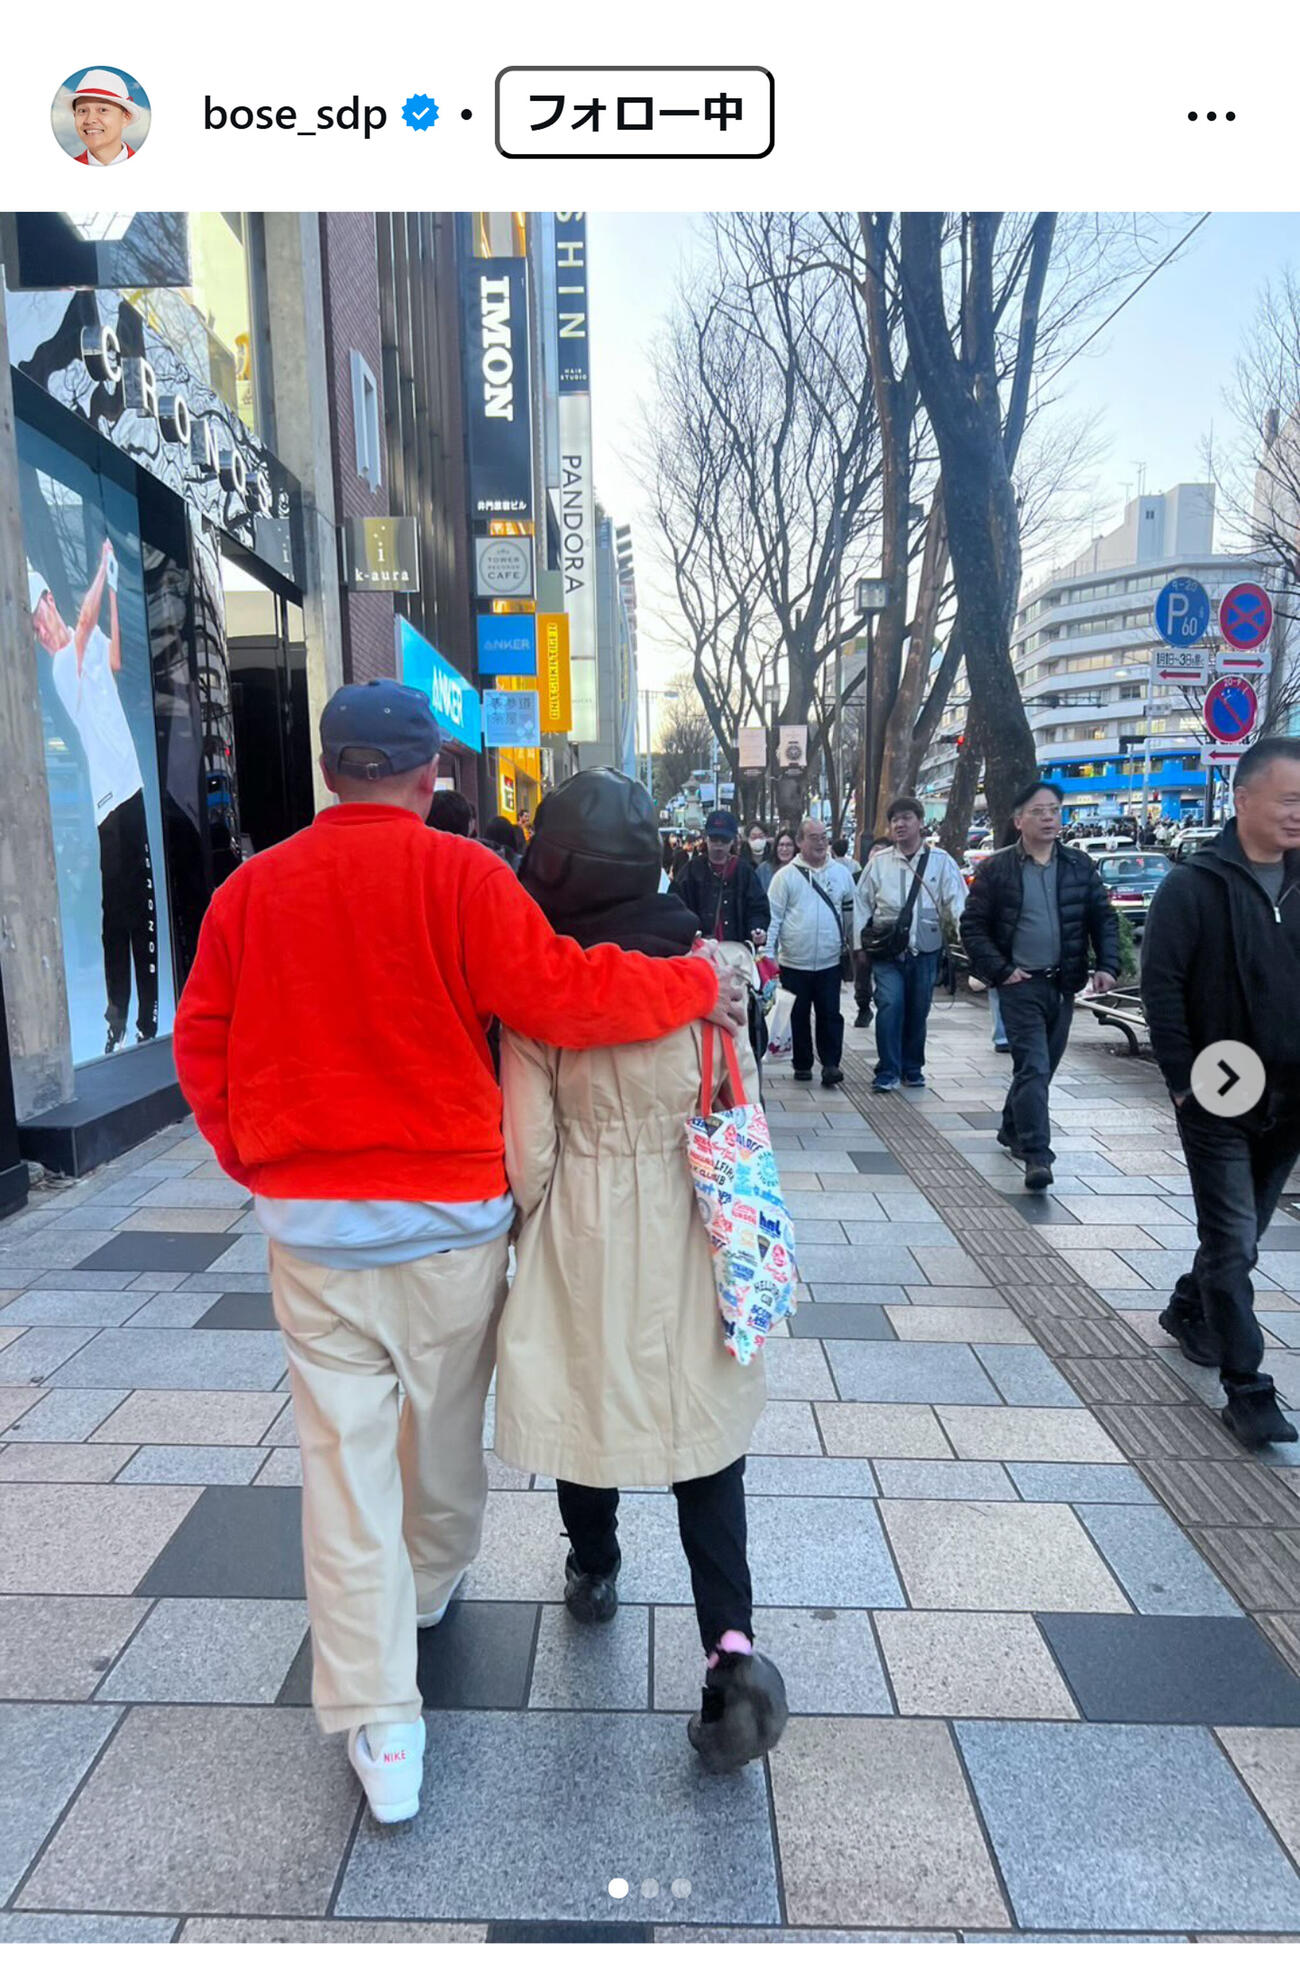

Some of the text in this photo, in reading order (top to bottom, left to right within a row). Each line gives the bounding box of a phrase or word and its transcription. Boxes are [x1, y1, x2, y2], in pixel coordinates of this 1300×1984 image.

[480, 275, 513, 422] IMON
[98, 325, 274, 513] CRONOS
[562, 455, 585, 595] PANDORA
[355, 567, 409, 582] k-aura
[487, 571, 520, 580] CAFE
[1167, 592, 1189, 636] P
[1181, 617, 1198, 637] 60
[484, 638, 531, 651] ANKER
[432, 665, 464, 729] ANKER
[384, 1749, 406, 1763] NIKE
